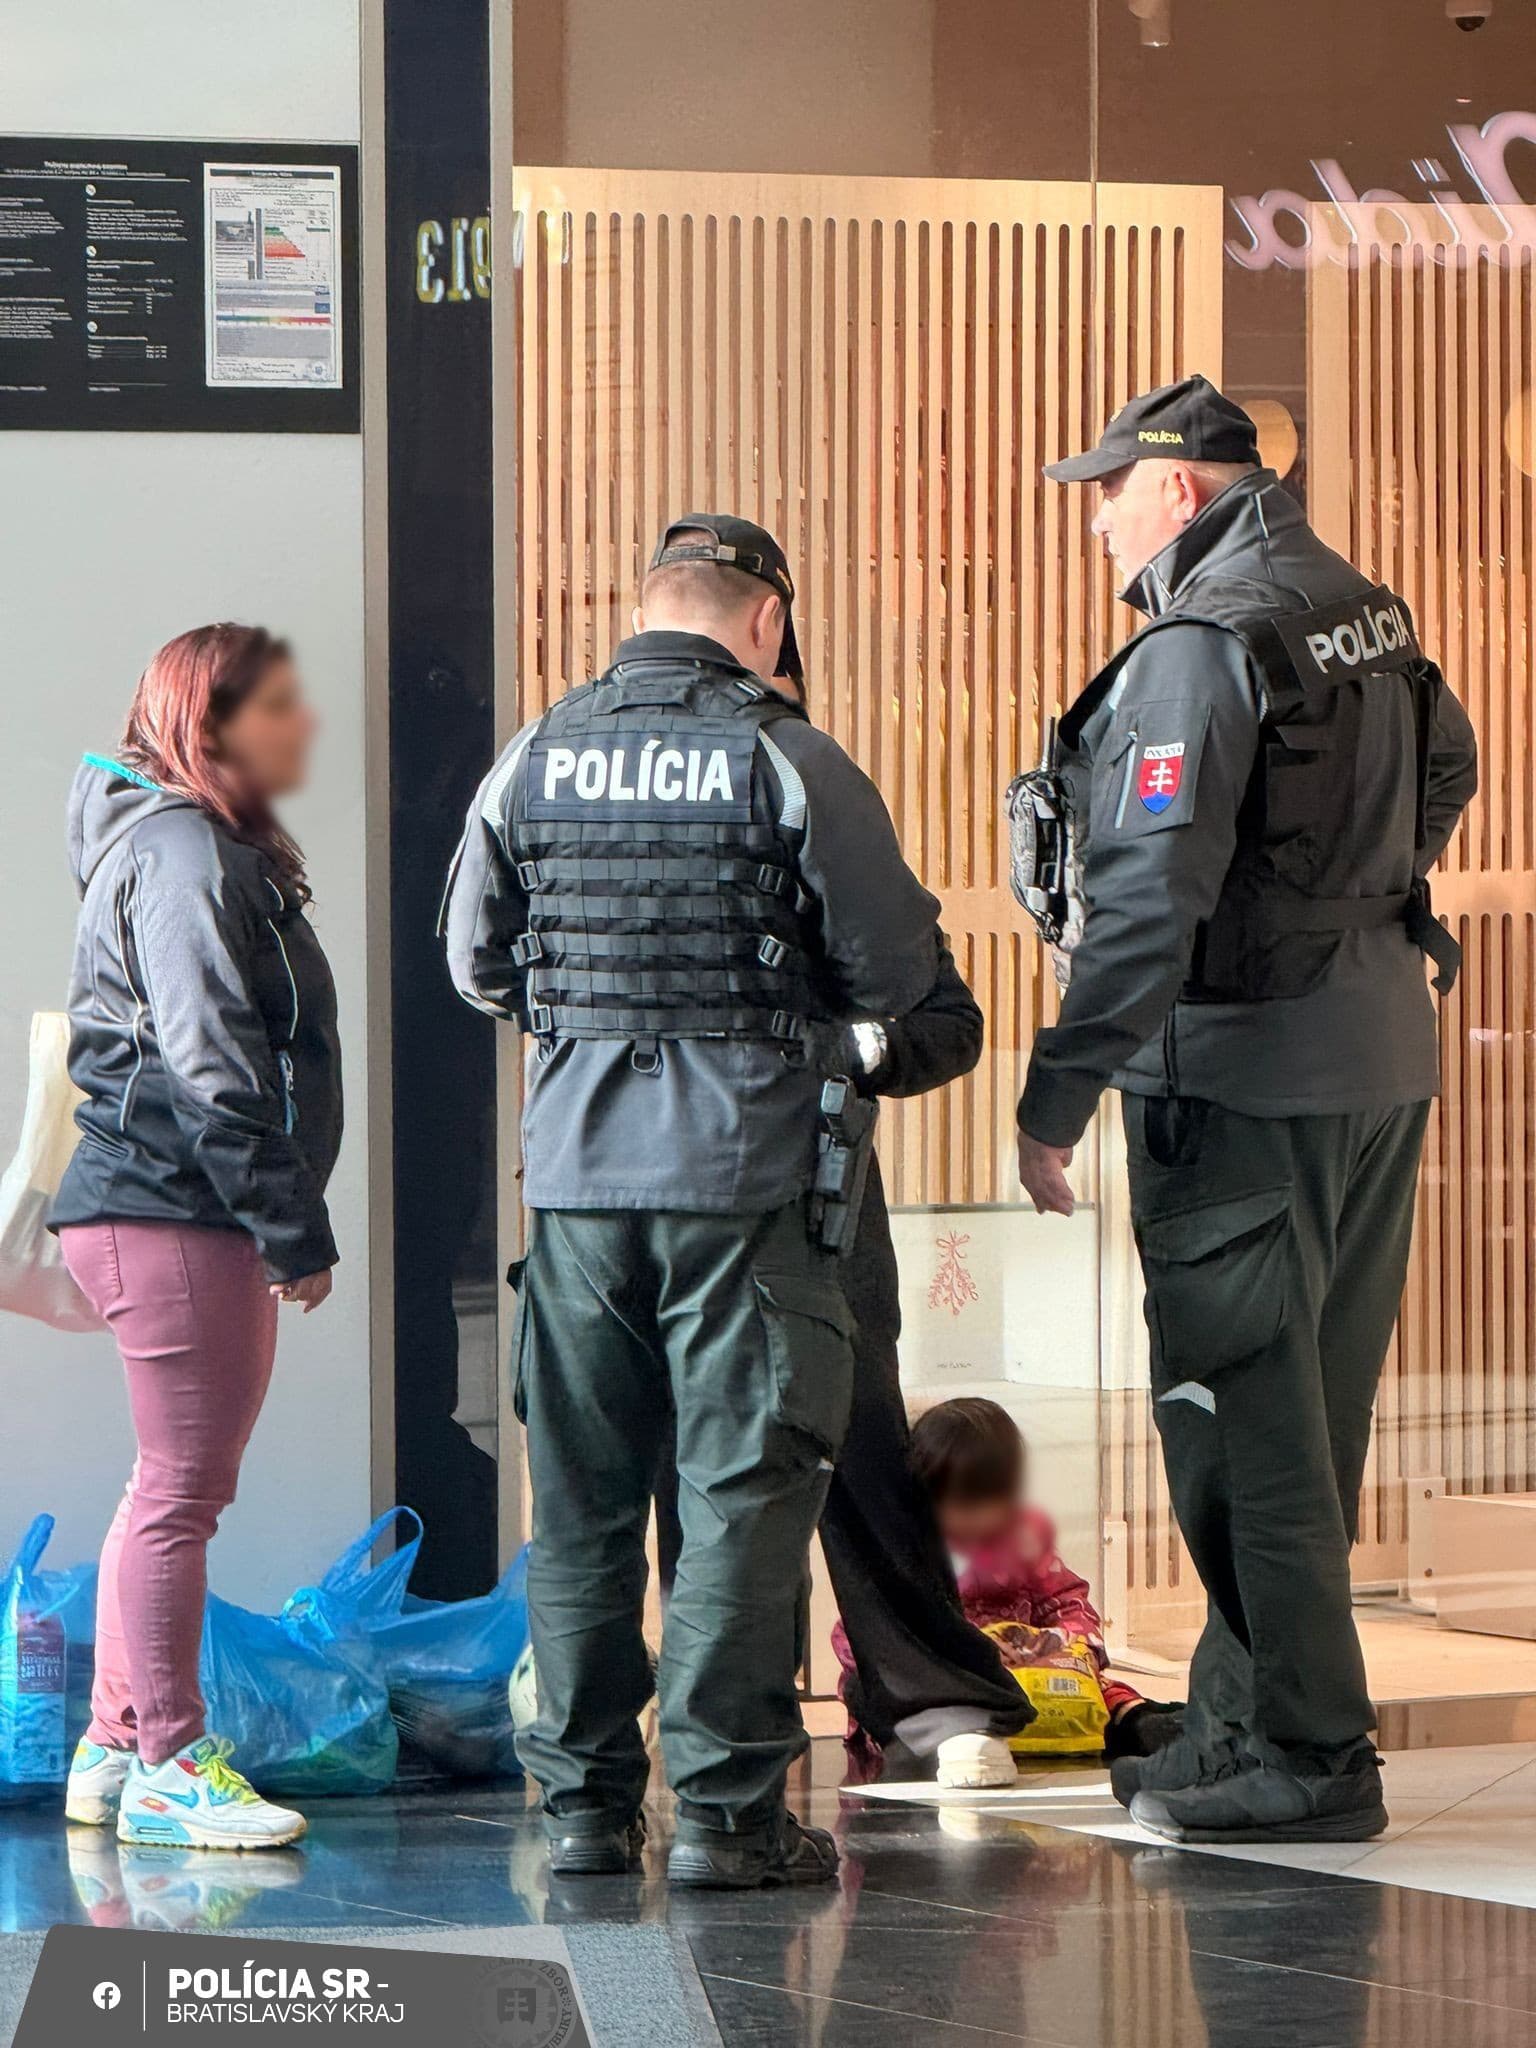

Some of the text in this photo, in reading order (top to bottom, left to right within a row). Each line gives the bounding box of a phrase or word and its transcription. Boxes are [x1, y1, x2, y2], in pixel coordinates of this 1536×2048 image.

[1138, 430, 1184, 444] POLÍCIA
[1305, 604, 1411, 674] POLÍCIA
[544, 739, 734, 801] POLÍCIA
